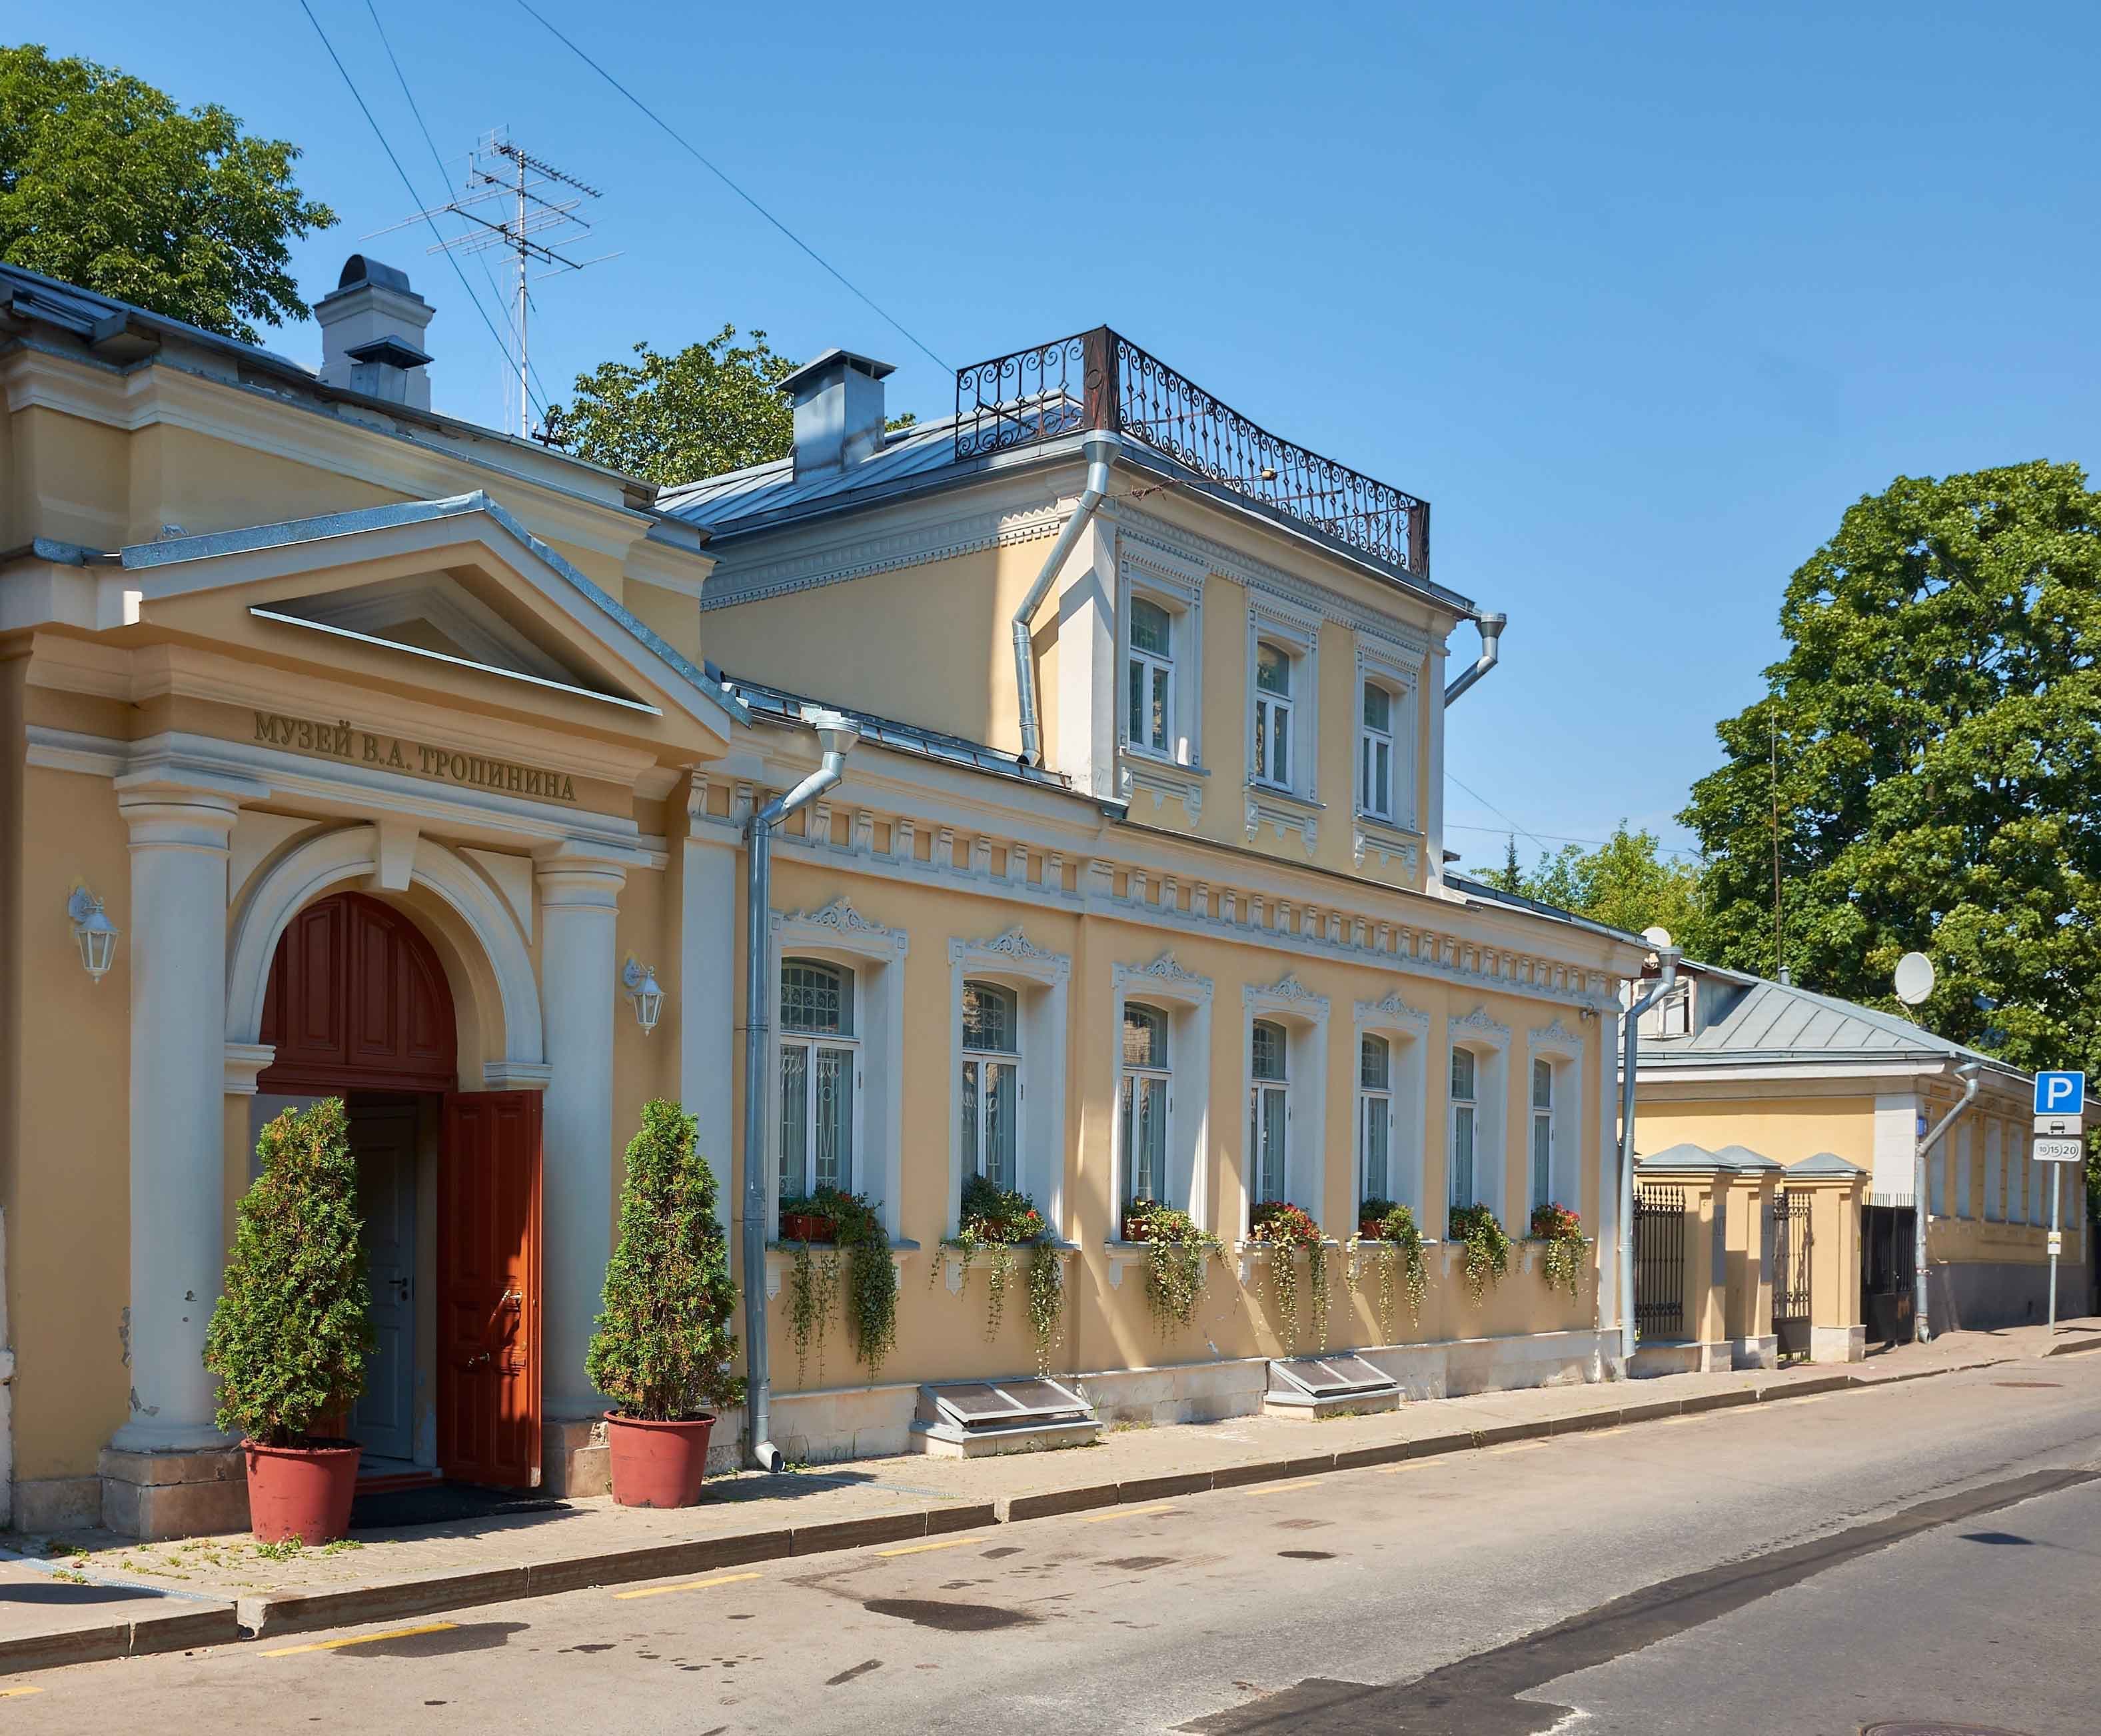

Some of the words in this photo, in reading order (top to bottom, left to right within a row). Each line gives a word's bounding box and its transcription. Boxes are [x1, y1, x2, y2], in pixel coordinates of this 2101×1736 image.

[253, 712, 354, 758] МУЗЕЙ
[362, 734, 412, 771] В.А.
[418, 744, 577, 802] ТРОПИНИНА
[2048, 1078, 2073, 1109] P
[2063, 1146, 2076, 1155] 20
